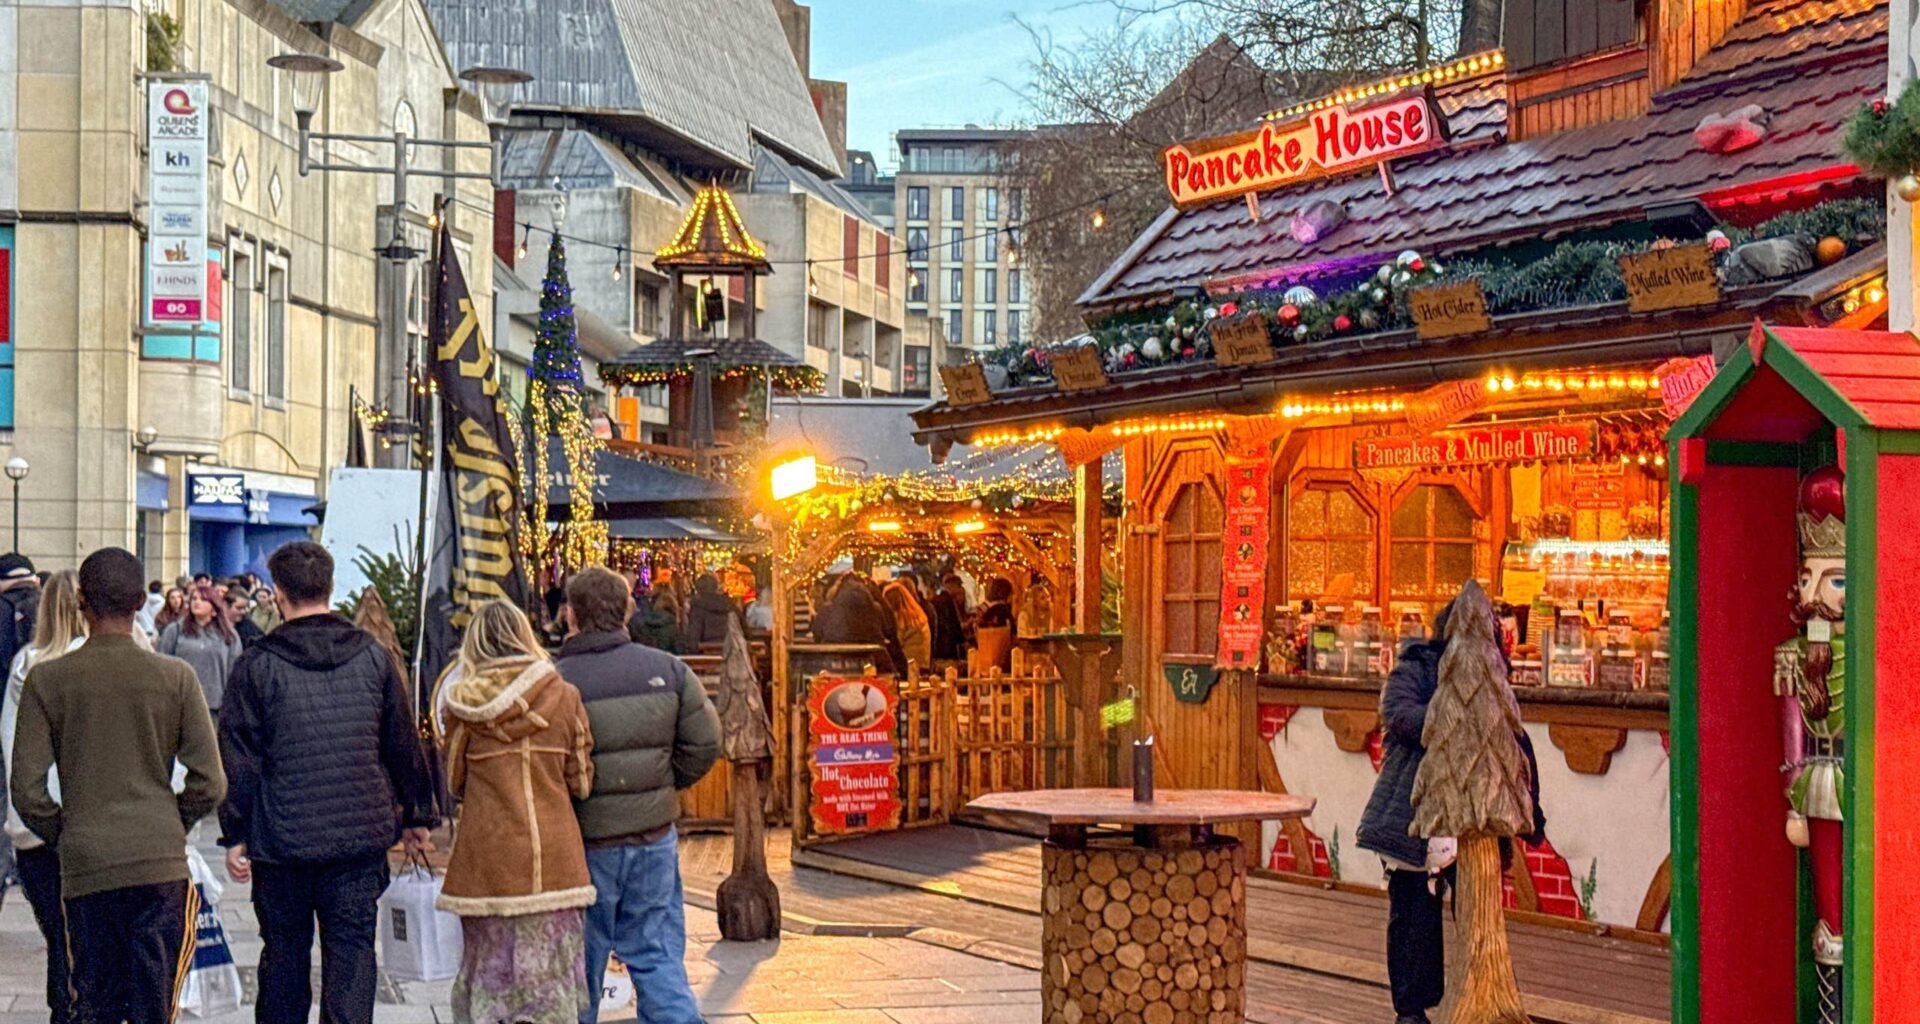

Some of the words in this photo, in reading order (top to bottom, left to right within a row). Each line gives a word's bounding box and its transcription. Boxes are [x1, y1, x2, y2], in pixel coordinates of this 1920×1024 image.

[158, 126, 198, 136] ARCADE
[165, 151, 190, 166] kh
[1167, 127, 1304, 197] Pancake
[1314, 103, 1424, 165] House
[1630, 270, 1672, 296] Mulled
[1670, 264, 1707, 285] Wine
[1419, 302, 1445, 321] Hot
[1443, 298, 1475, 320] Cider
[1366, 441, 1440, 467] Pancakes
[1445, 441, 1458, 459] &
[1463, 434, 1526, 462] Mulled
[1531, 431, 1579, 456] Wine
[820, 733, 838, 745] THE
[839, 732, 861, 744] REAL
[862, 731, 888, 743] THING
[821, 766, 839, 781] Hot
[840, 773, 889, 790] Chocolate
